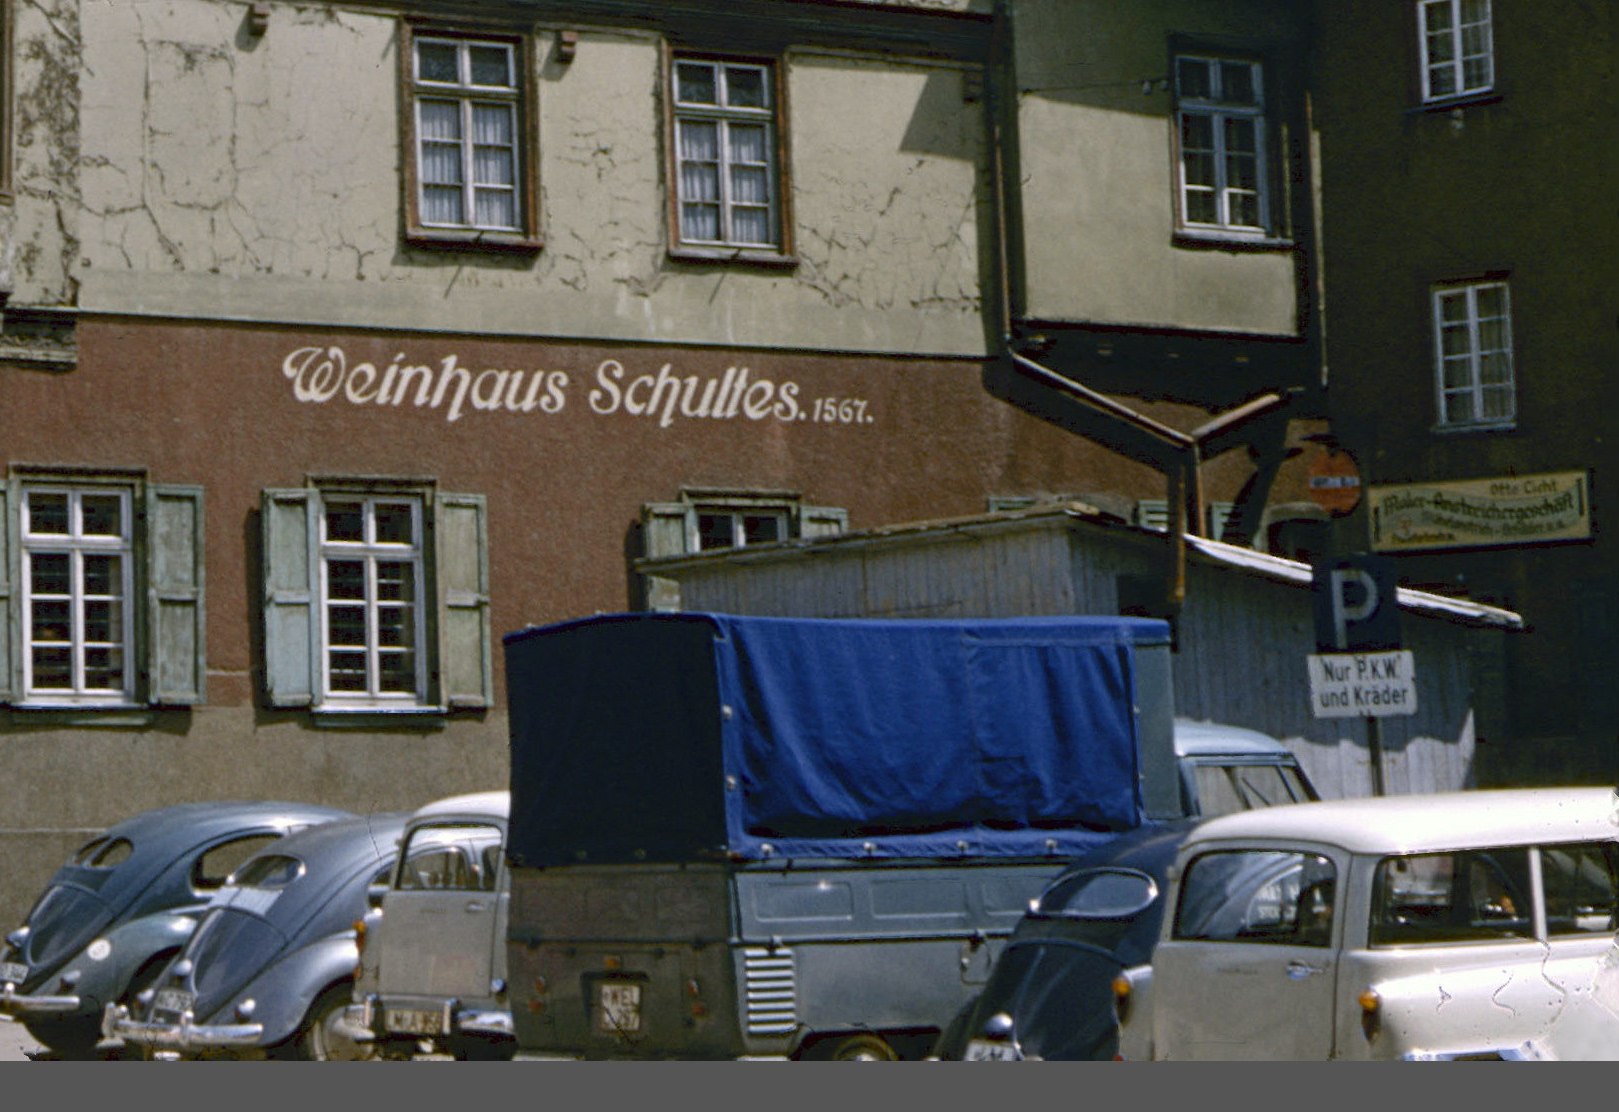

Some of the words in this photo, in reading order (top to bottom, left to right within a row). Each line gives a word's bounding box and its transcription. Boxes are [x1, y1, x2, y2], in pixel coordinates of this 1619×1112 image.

[282, 346, 569, 422] Weinhaus
[812, 397, 875, 424] 1567.
[1331, 569, 1379, 650] P
[1323, 657, 1351, 682] Nur
[1320, 688, 1349, 707] und
[1354, 685, 1408, 706] Kräder
